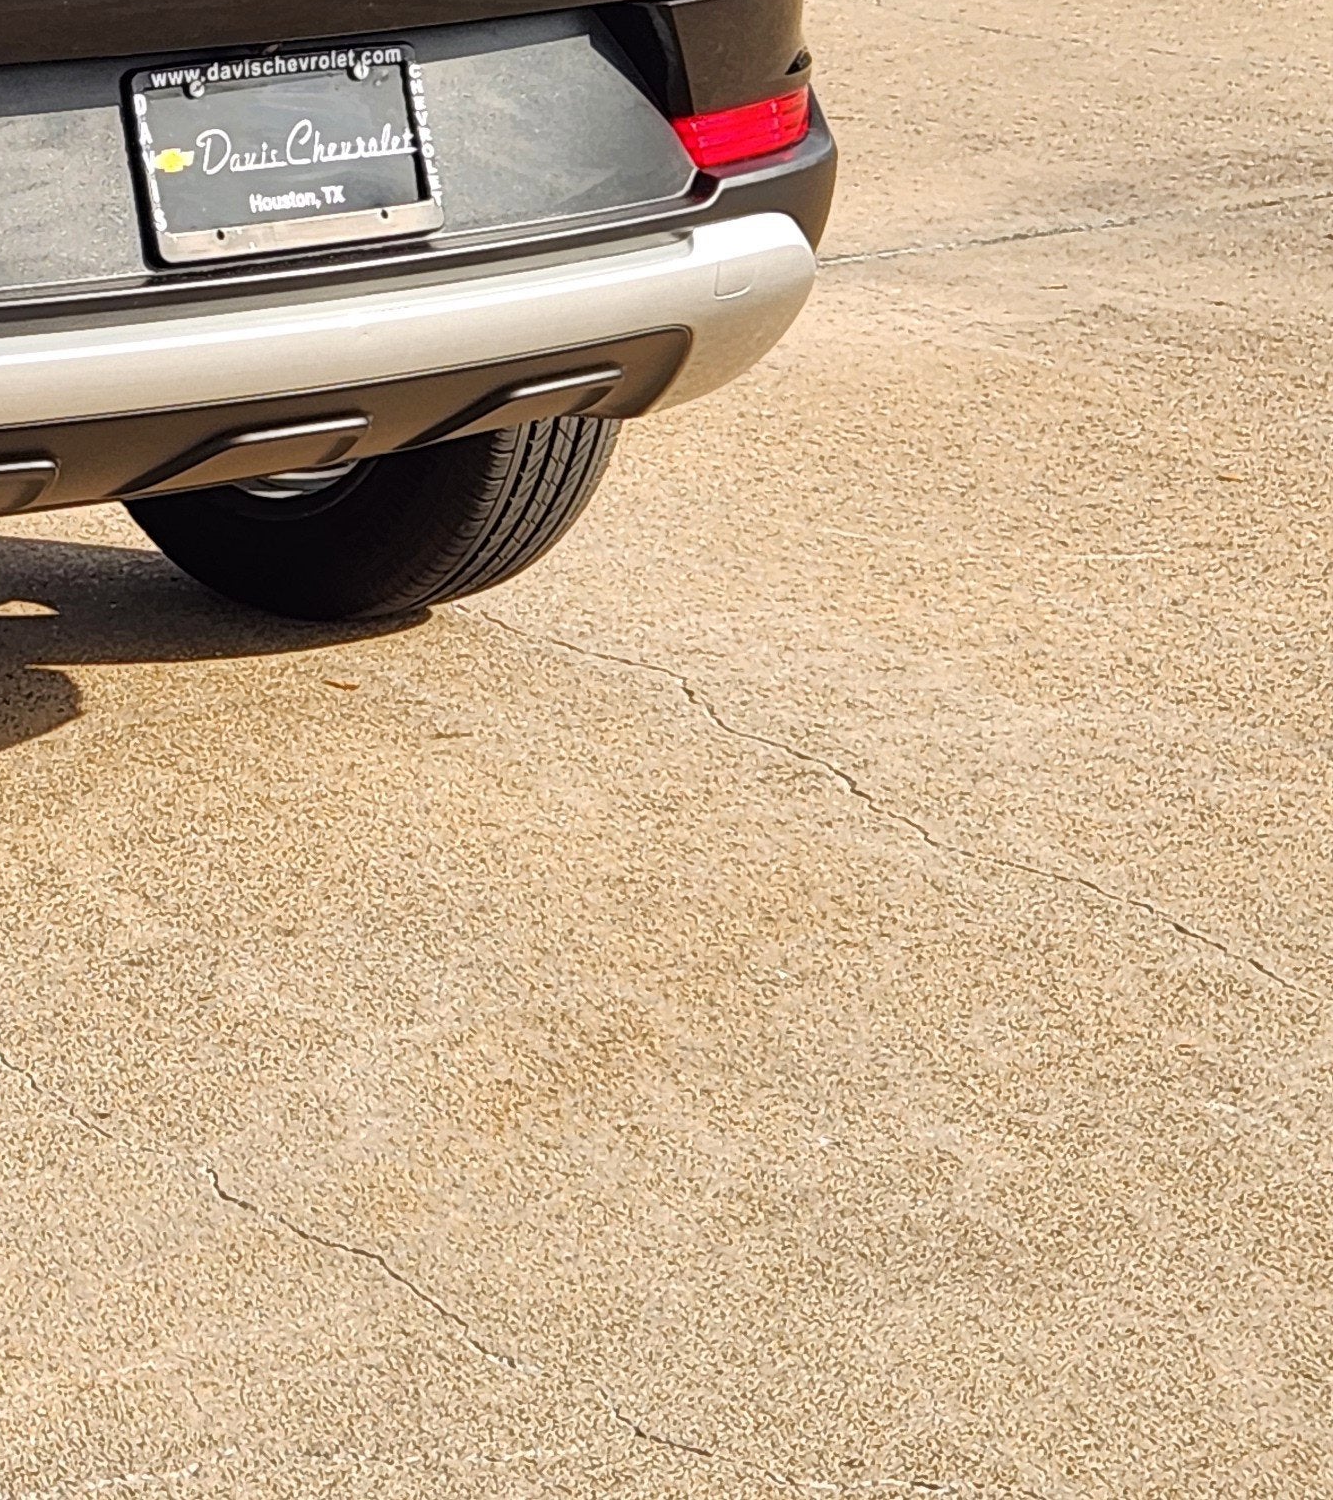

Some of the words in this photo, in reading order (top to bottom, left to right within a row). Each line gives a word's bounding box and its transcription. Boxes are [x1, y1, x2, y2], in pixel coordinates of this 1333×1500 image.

[150, 47, 402, 88] www.davischevrolet.com
[195, 128, 288, 176] Davis
[286, 119, 418, 167] Chevrolet
[408, 63, 444, 208] CHEVROLET
[249, 190, 322, 214] Houston,
[320, 185, 347, 204] TX
